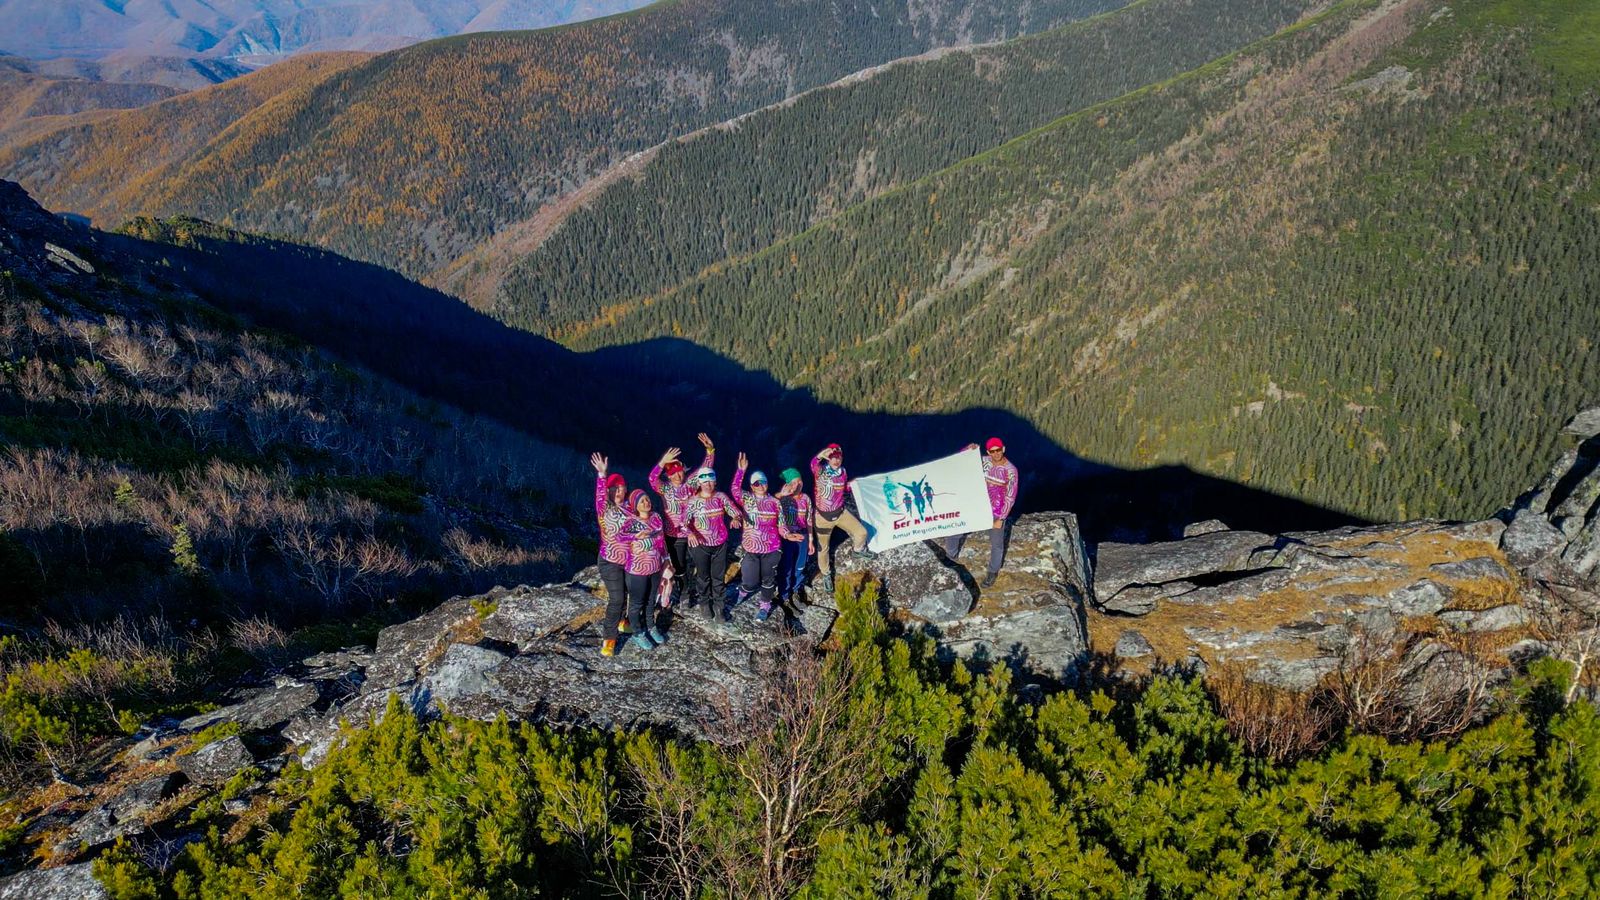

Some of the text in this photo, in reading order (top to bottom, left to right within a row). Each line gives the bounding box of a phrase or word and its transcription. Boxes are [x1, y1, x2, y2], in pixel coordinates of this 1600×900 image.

[893, 516, 911, 530] Бег
[924, 511, 961, 522] мечте
[892, 532, 911, 540] Amur
[912, 526, 938, 535] Region
